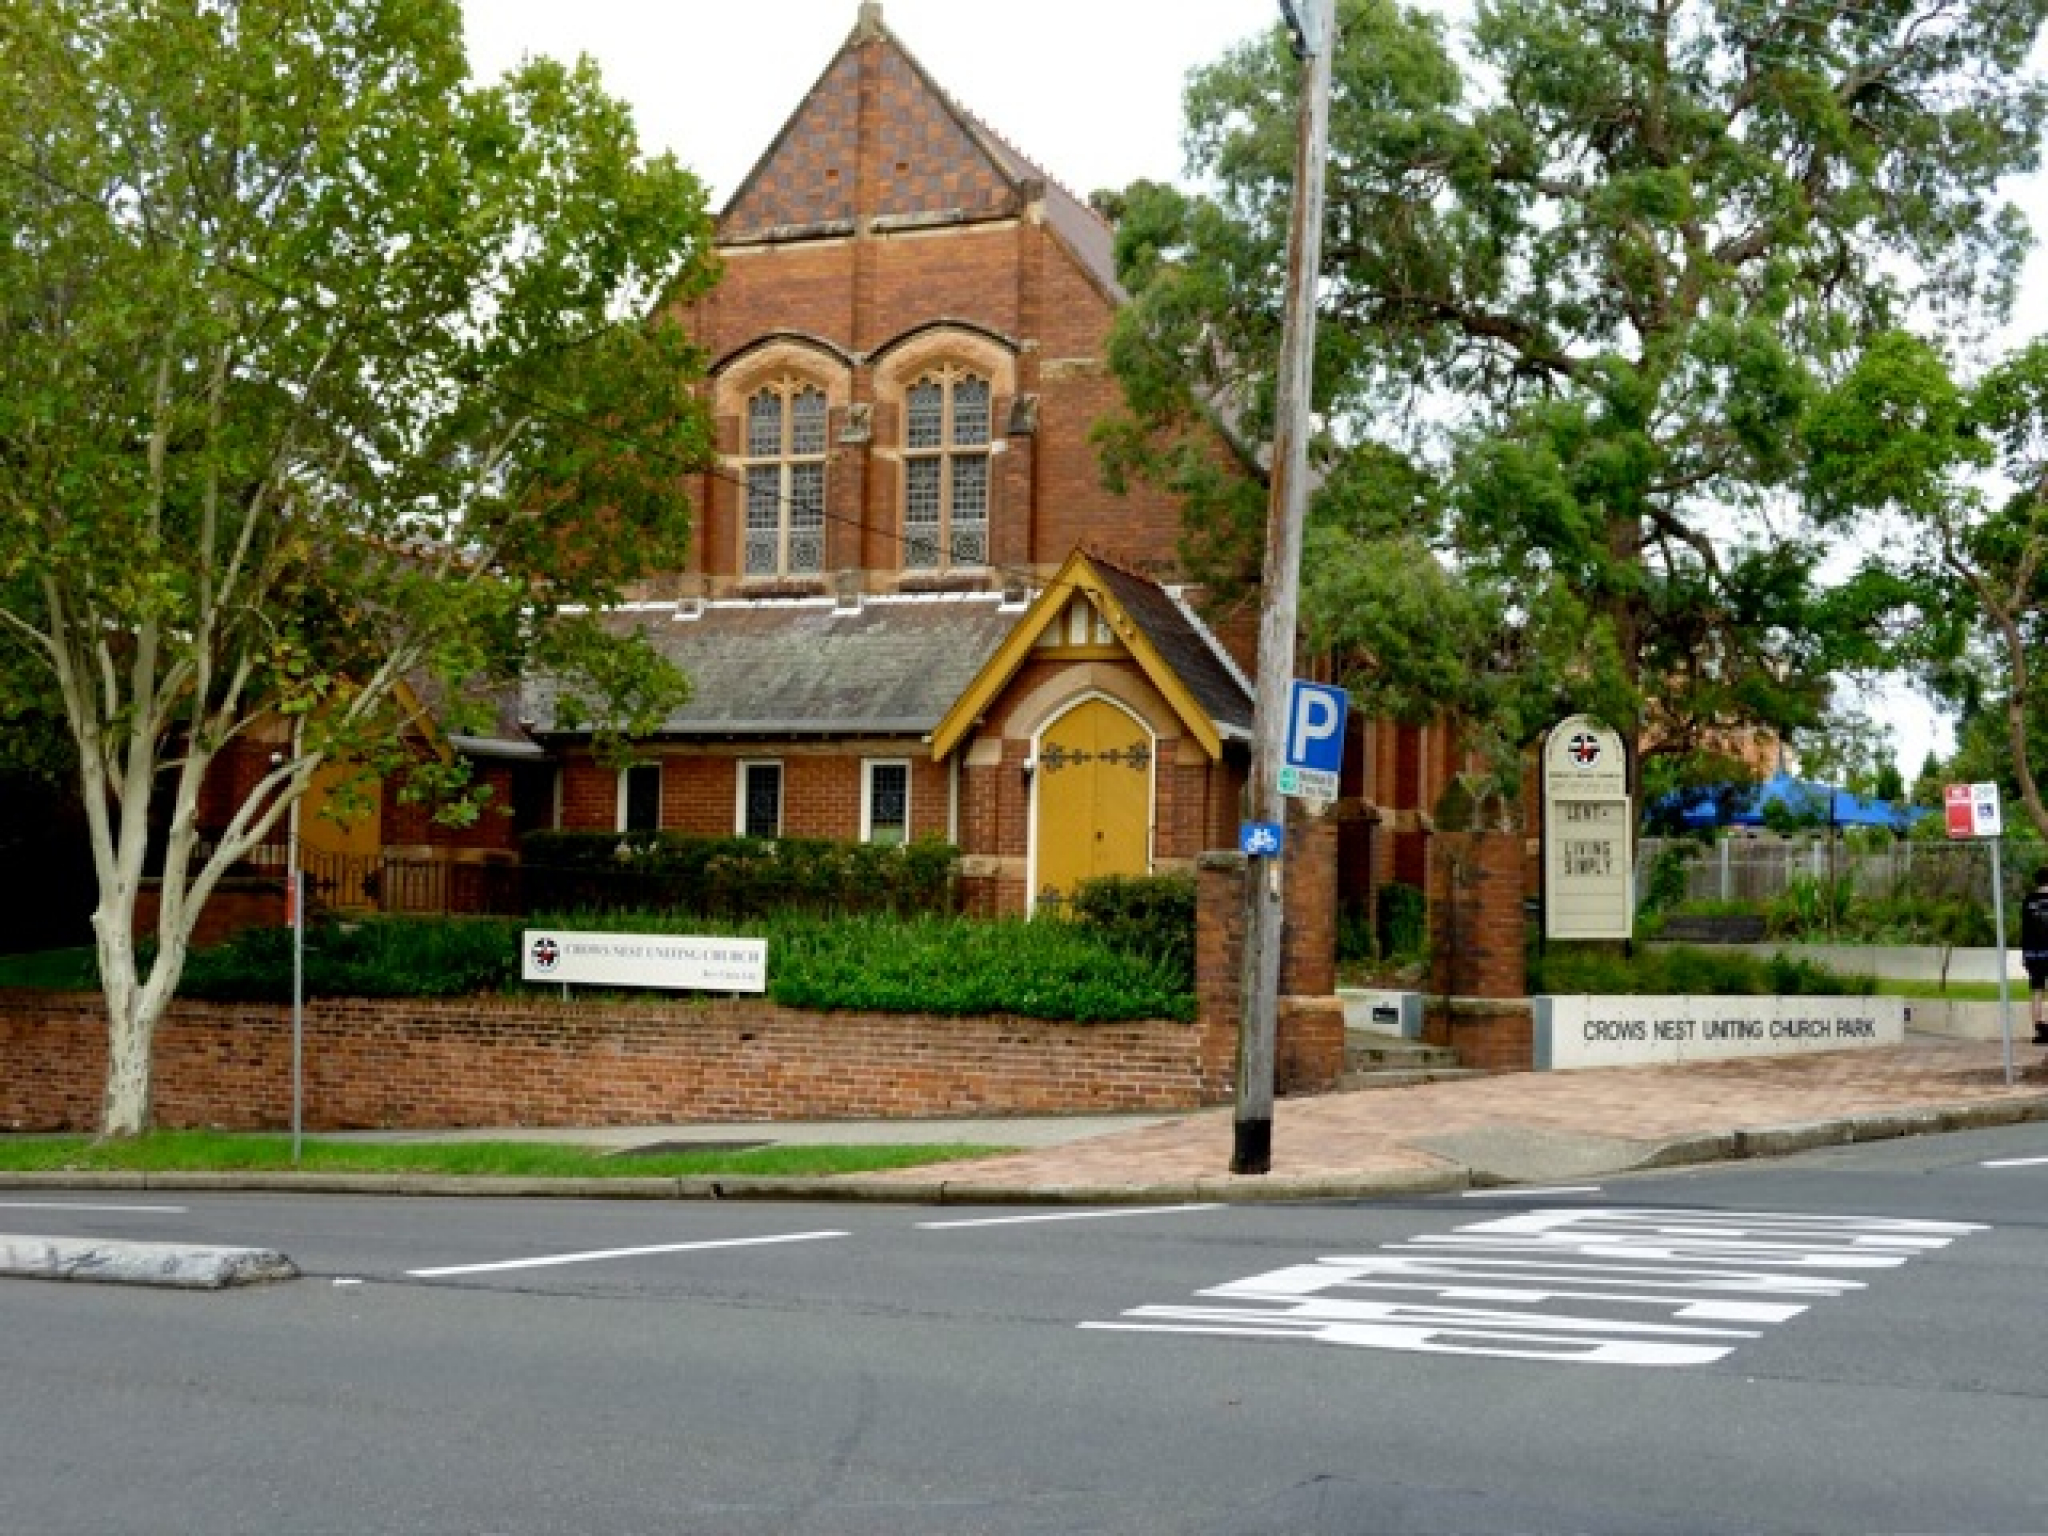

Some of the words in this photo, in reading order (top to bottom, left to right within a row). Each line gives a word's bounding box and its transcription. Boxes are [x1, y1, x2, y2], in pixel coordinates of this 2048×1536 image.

[1291, 689, 1339, 762] P
[1565, 841, 1610, 856] LIVING
[702, 948, 760, 963] CHURCH
[1583, 1019, 1648, 1041] CROWS
[1653, 1019, 1697, 1040] NEST
[1702, 1018, 1764, 1040] UNITING
[1769, 1017, 1832, 1039] CHURCH
[1835, 1016, 1876, 1038] PARK
